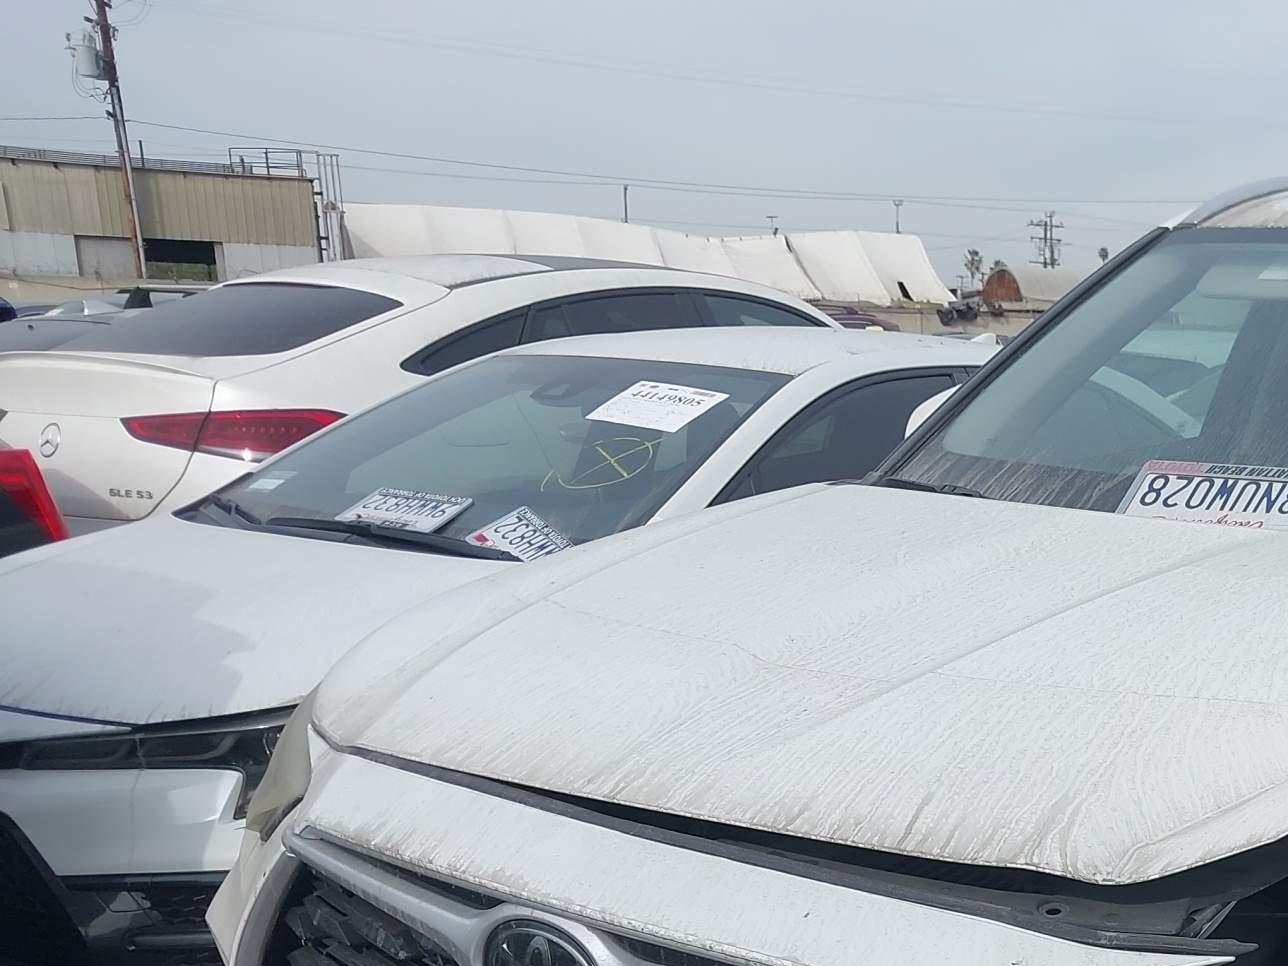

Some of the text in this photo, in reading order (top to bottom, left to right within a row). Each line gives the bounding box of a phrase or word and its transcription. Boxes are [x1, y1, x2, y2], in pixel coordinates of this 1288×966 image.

[631, 390, 706, 407] 44149805
[1205, 464, 1246, 476] BEACH
[108, 488, 153, 499] GLE 53
